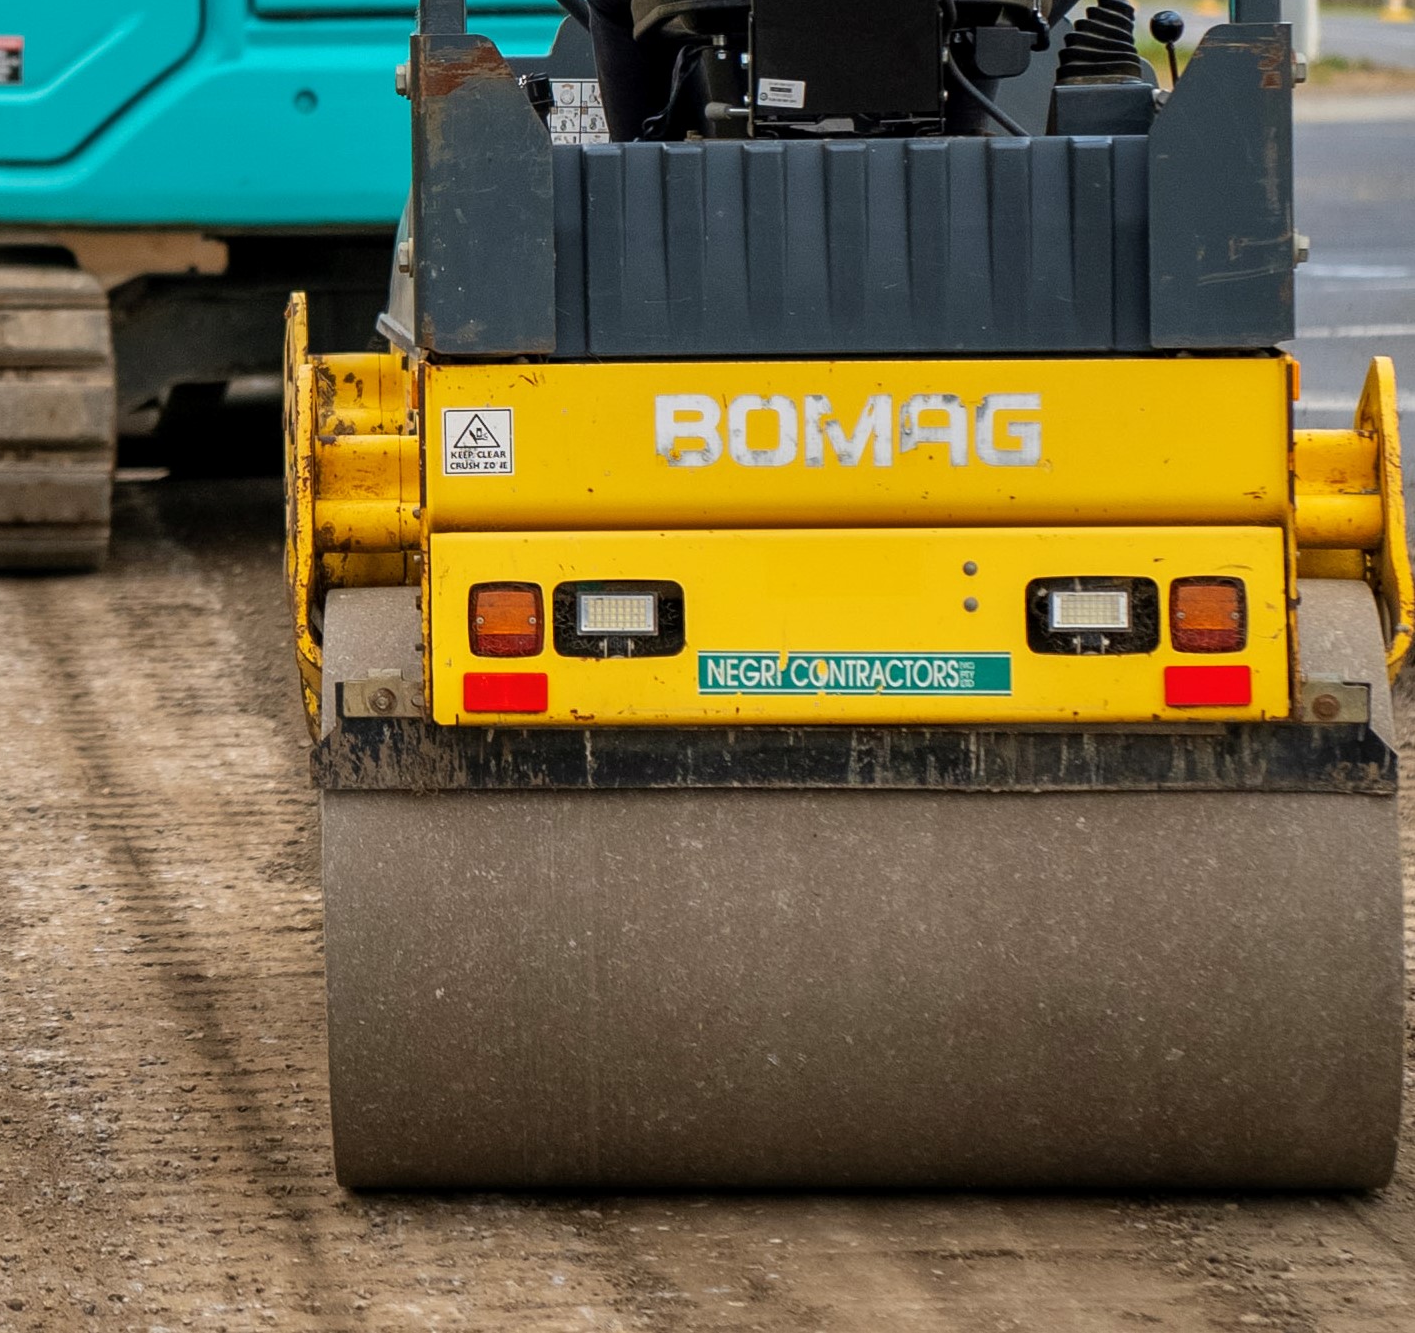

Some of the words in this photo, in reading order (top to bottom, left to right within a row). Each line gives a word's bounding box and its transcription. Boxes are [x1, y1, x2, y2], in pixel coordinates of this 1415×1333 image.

[655, 393, 1042, 467] BOMAG
[451, 451, 474, 459] KEEP
[477, 450, 507, 458] CLEAR
[450, 462, 480, 470] CRUSH
[707, 659, 782, 687] NEGRI
[790, 659, 959, 688] CONTRACTORS
